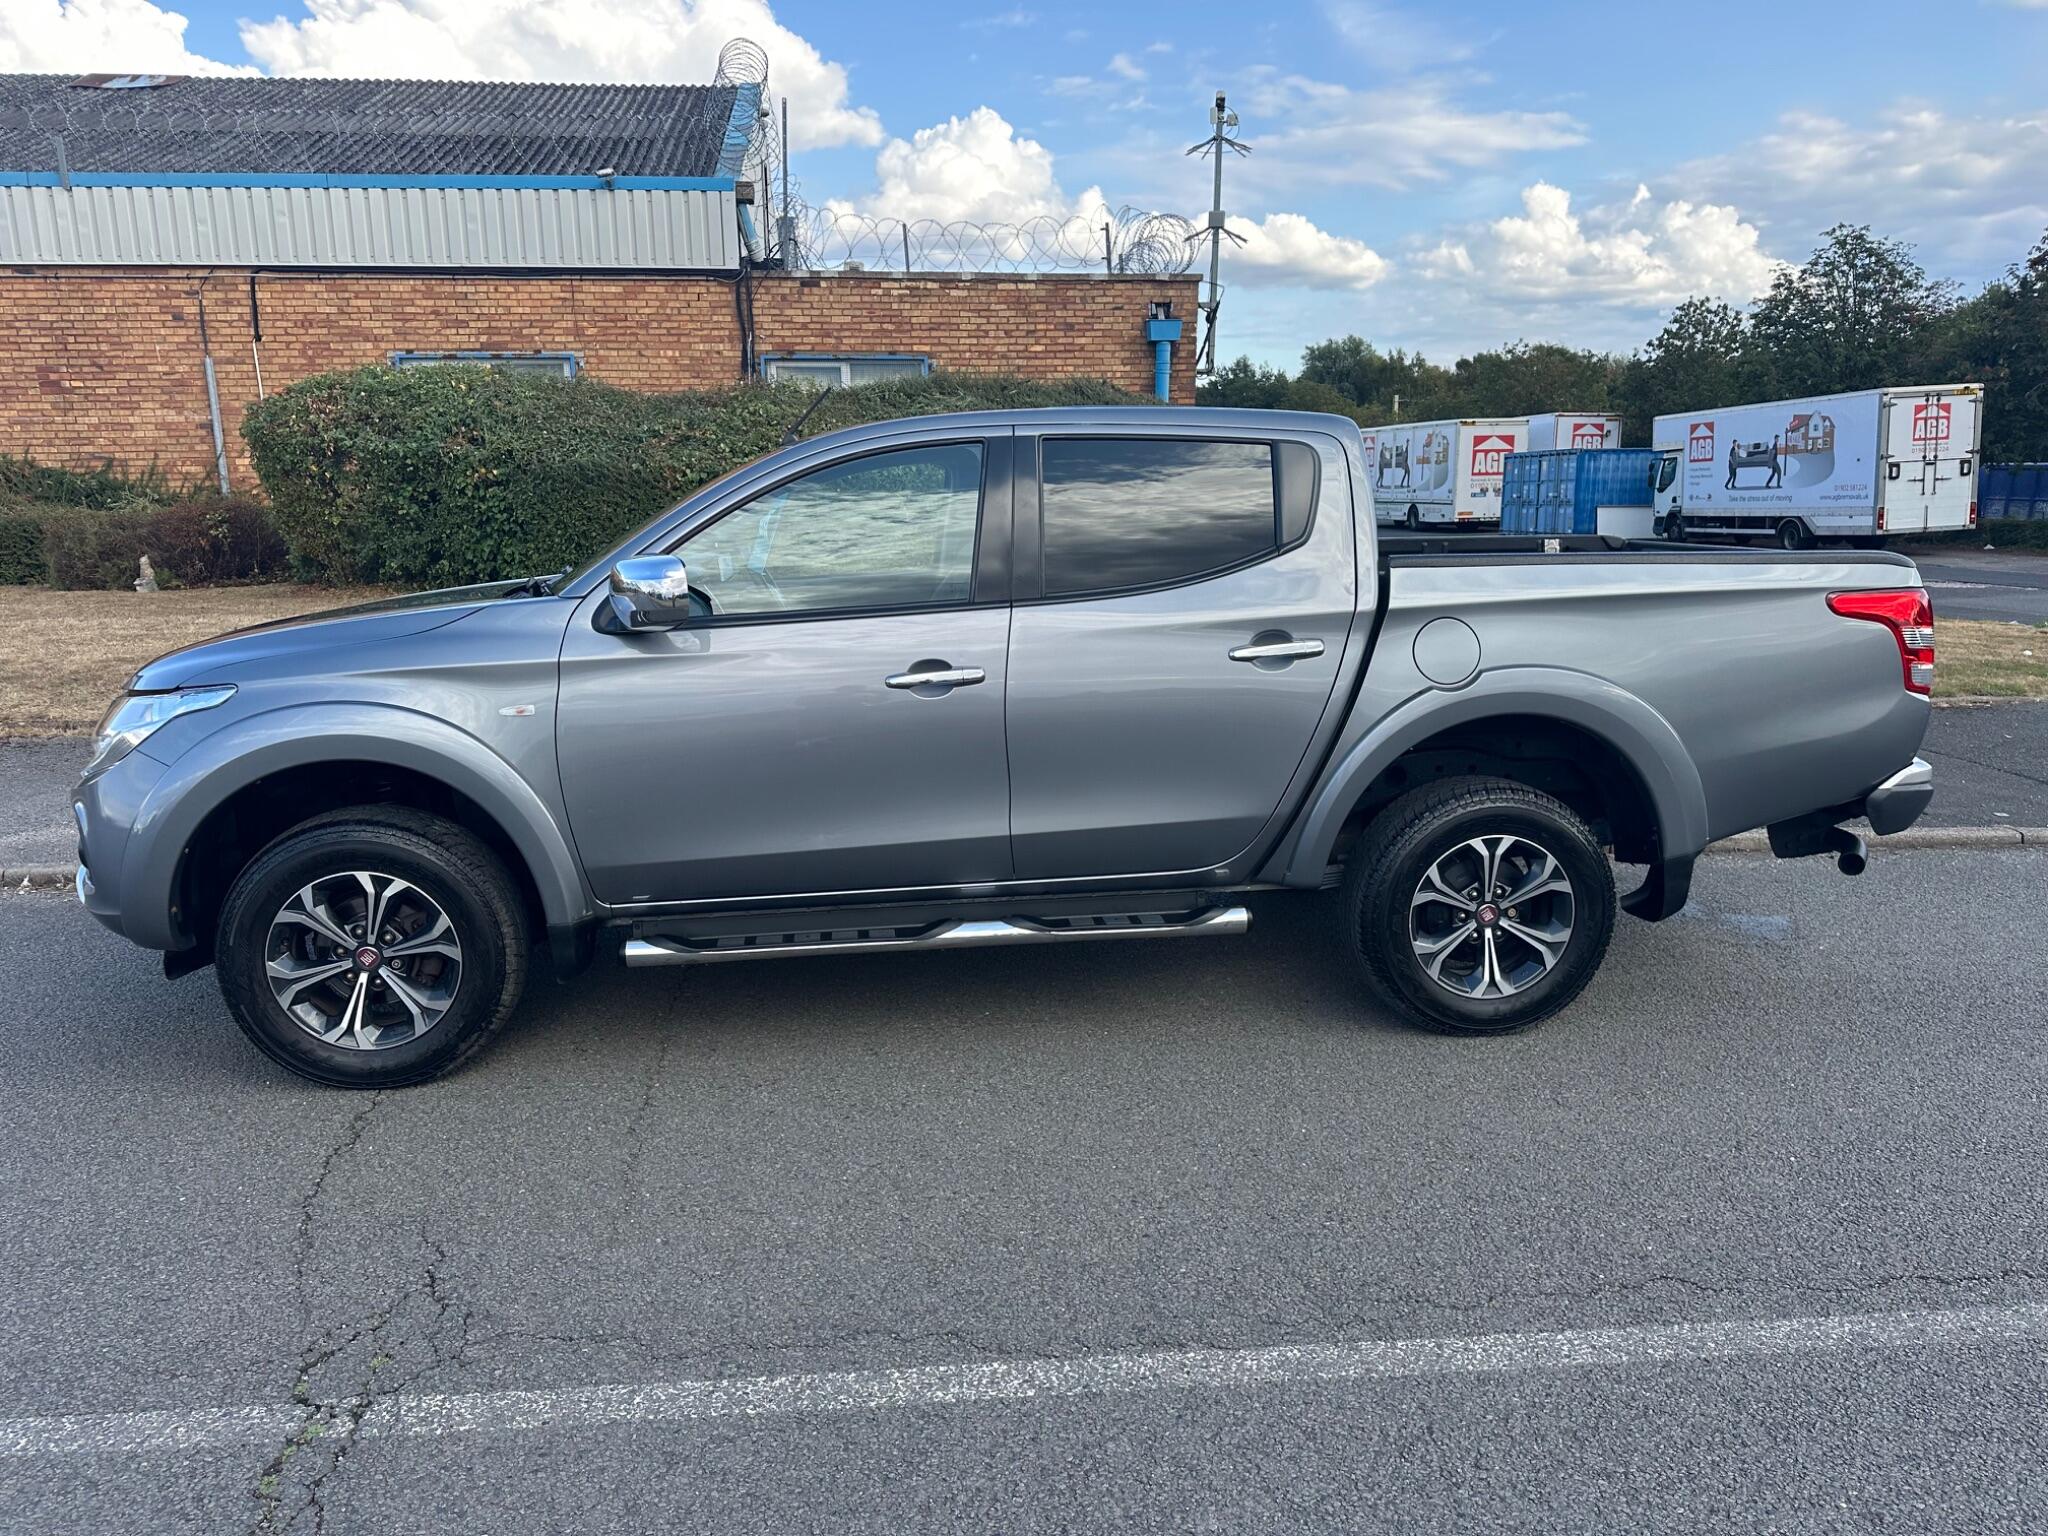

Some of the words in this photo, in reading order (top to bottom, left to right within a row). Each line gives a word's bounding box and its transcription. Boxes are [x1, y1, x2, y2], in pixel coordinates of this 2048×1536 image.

[1914, 418, 1949, 439] AGB
[1690, 438, 1714, 461] AGB
[1775, 494, 1793, 503] moving
